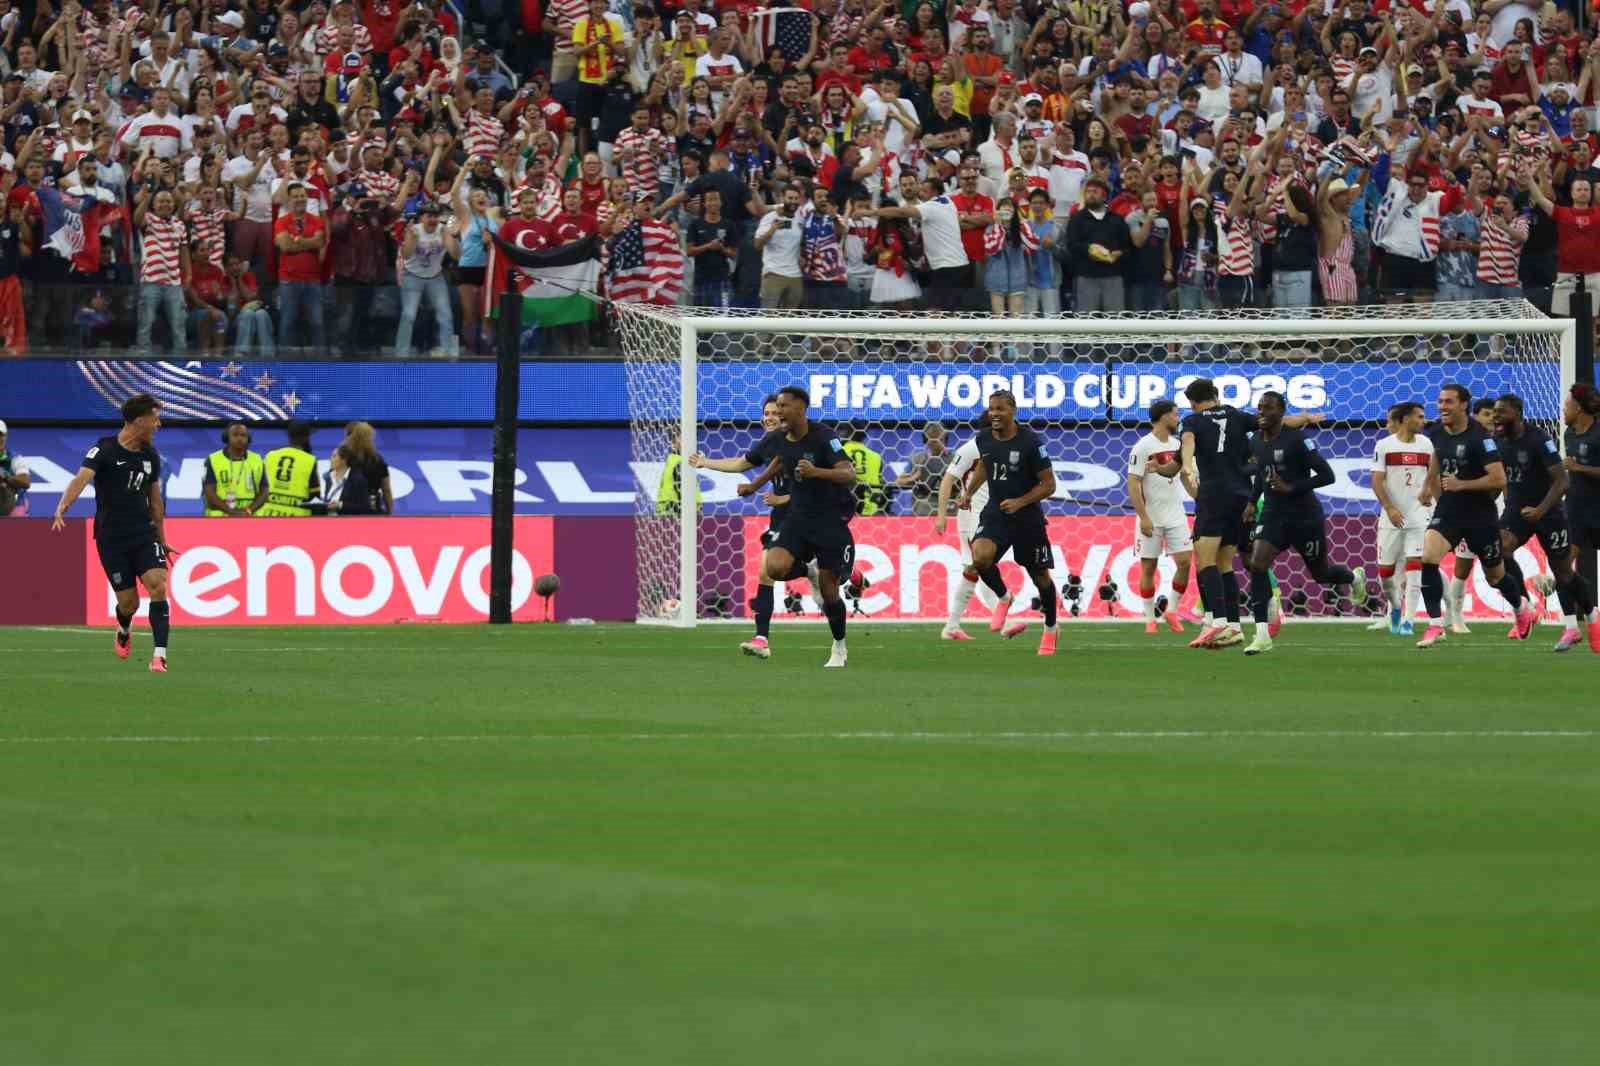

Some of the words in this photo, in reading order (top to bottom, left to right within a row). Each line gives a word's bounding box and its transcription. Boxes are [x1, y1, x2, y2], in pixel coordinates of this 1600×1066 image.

[809, 374, 901, 408] FIFA
[907, 374, 1066, 408] WORLD
[1073, 374, 1166, 408] CUP
[1212, 418, 1227, 452] 7
[992, 462, 1008, 480] 12
[1406, 472, 1412, 486] 2
[1551, 528, 1568, 549] 22
[844, 545, 850, 563] 6
[1305, 541, 1320, 556] 21
